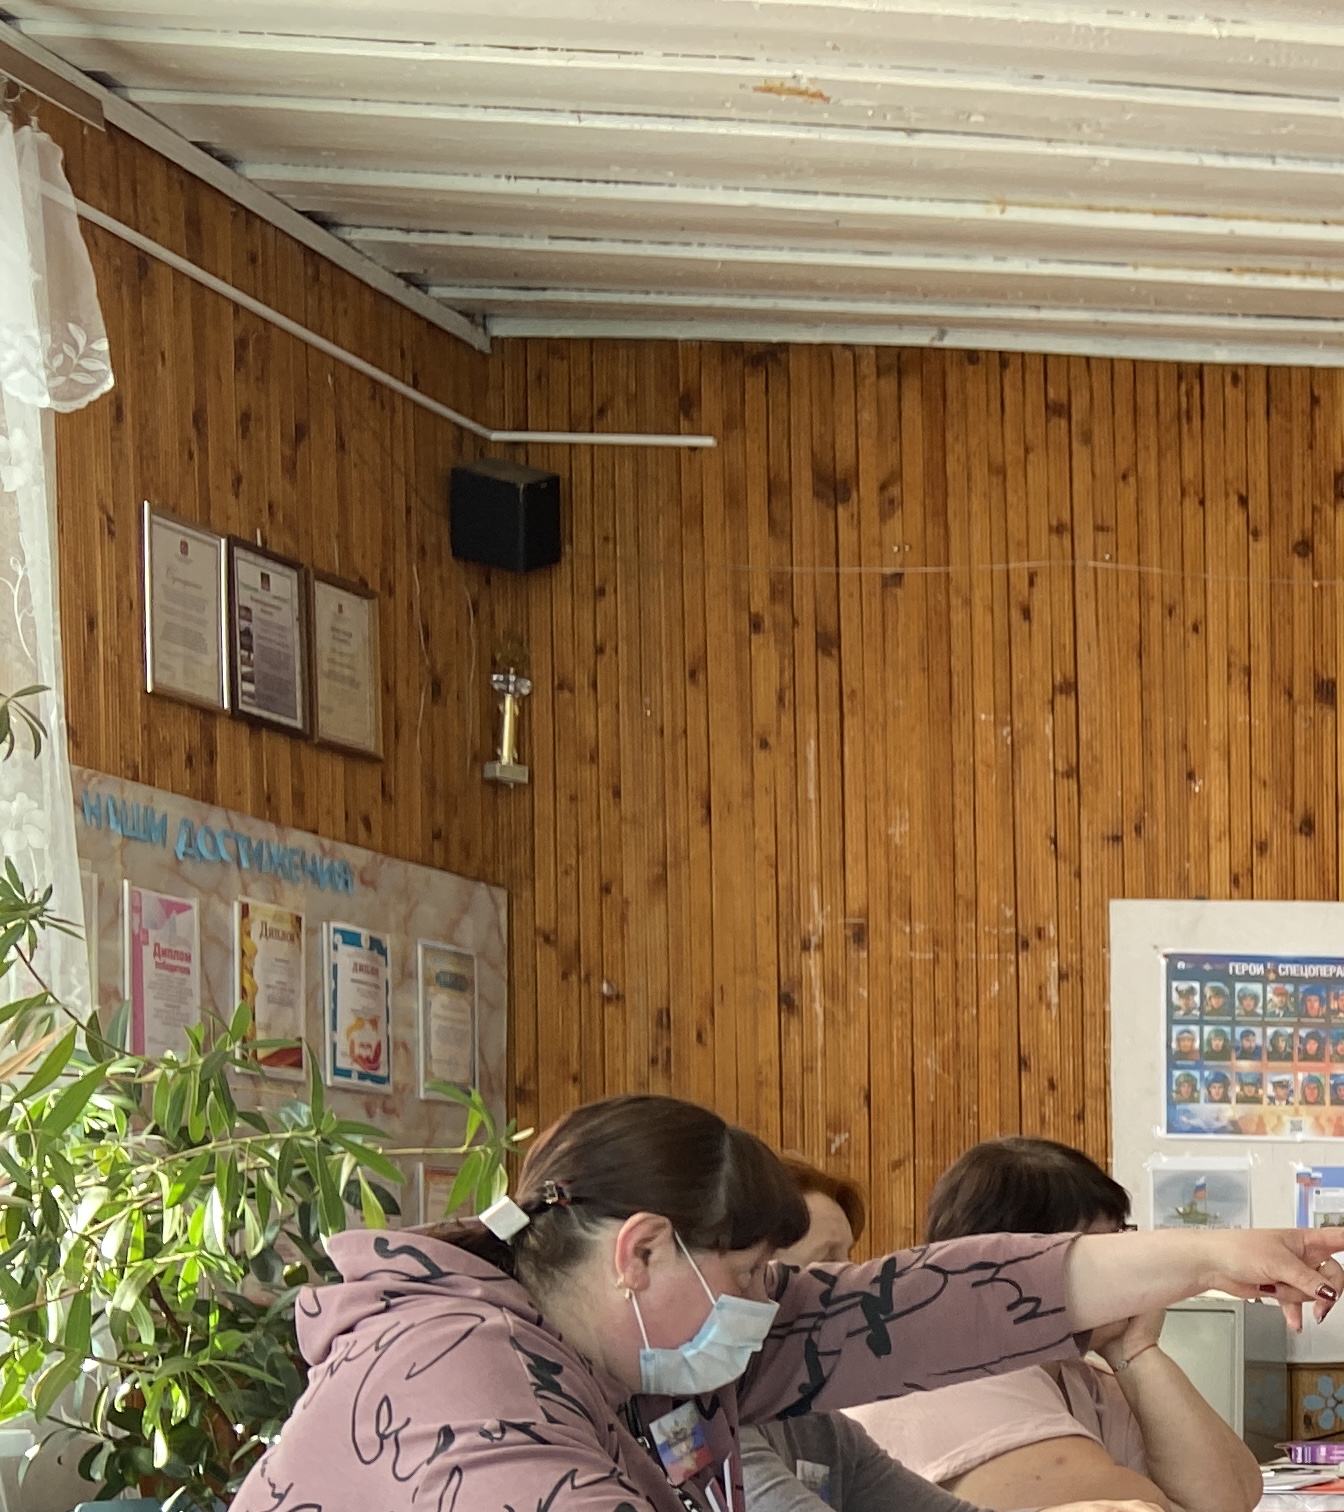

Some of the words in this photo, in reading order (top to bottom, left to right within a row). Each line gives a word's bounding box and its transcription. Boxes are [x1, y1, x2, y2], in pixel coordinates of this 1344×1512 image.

[82, 789, 168, 848] НАШИ
[175, 816, 354, 894] ДОСТИЖЕНИЯ
[153, 942, 192, 964] Диплом
[1228, 961, 1265, 977] ГЕРОИ
